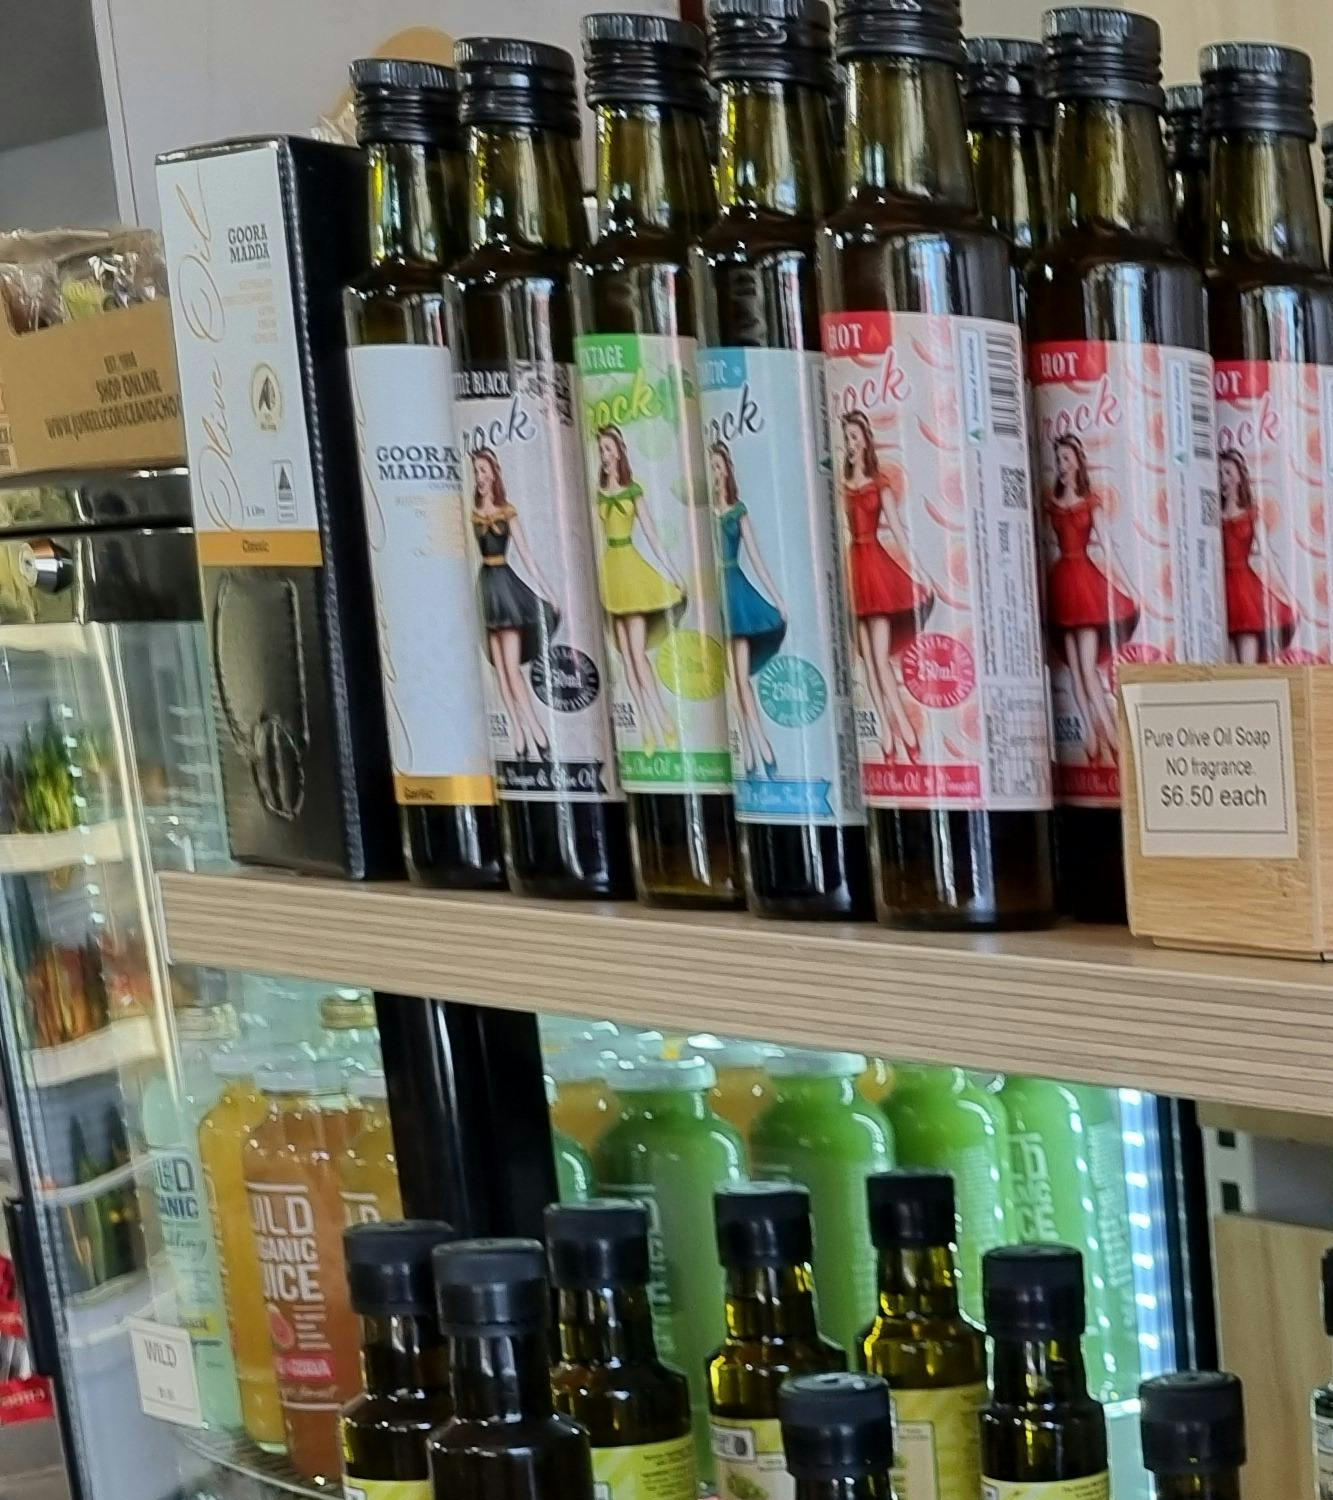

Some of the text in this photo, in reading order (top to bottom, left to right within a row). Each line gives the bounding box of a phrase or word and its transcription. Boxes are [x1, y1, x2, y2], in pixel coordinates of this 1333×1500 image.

[227, 223, 268, 245] GOORA
[229, 242, 270, 264] MADDA
[826, 322, 864, 351] HOT
[1041, 351, 1080, 379] HOT
[472, 371, 511, 395] BLACK
[1214, 369, 1243, 397] OT
[376, 444, 463, 465] GOORA
[378, 463, 464, 482] MADDA
[1143, 725, 1271, 749] Pure Olive Oil Soap
[1166, 756, 1257, 781] NO fragrance.
[1160, 784, 1268, 807] $6.50 each
[143, 1339, 178, 1369] WILD
